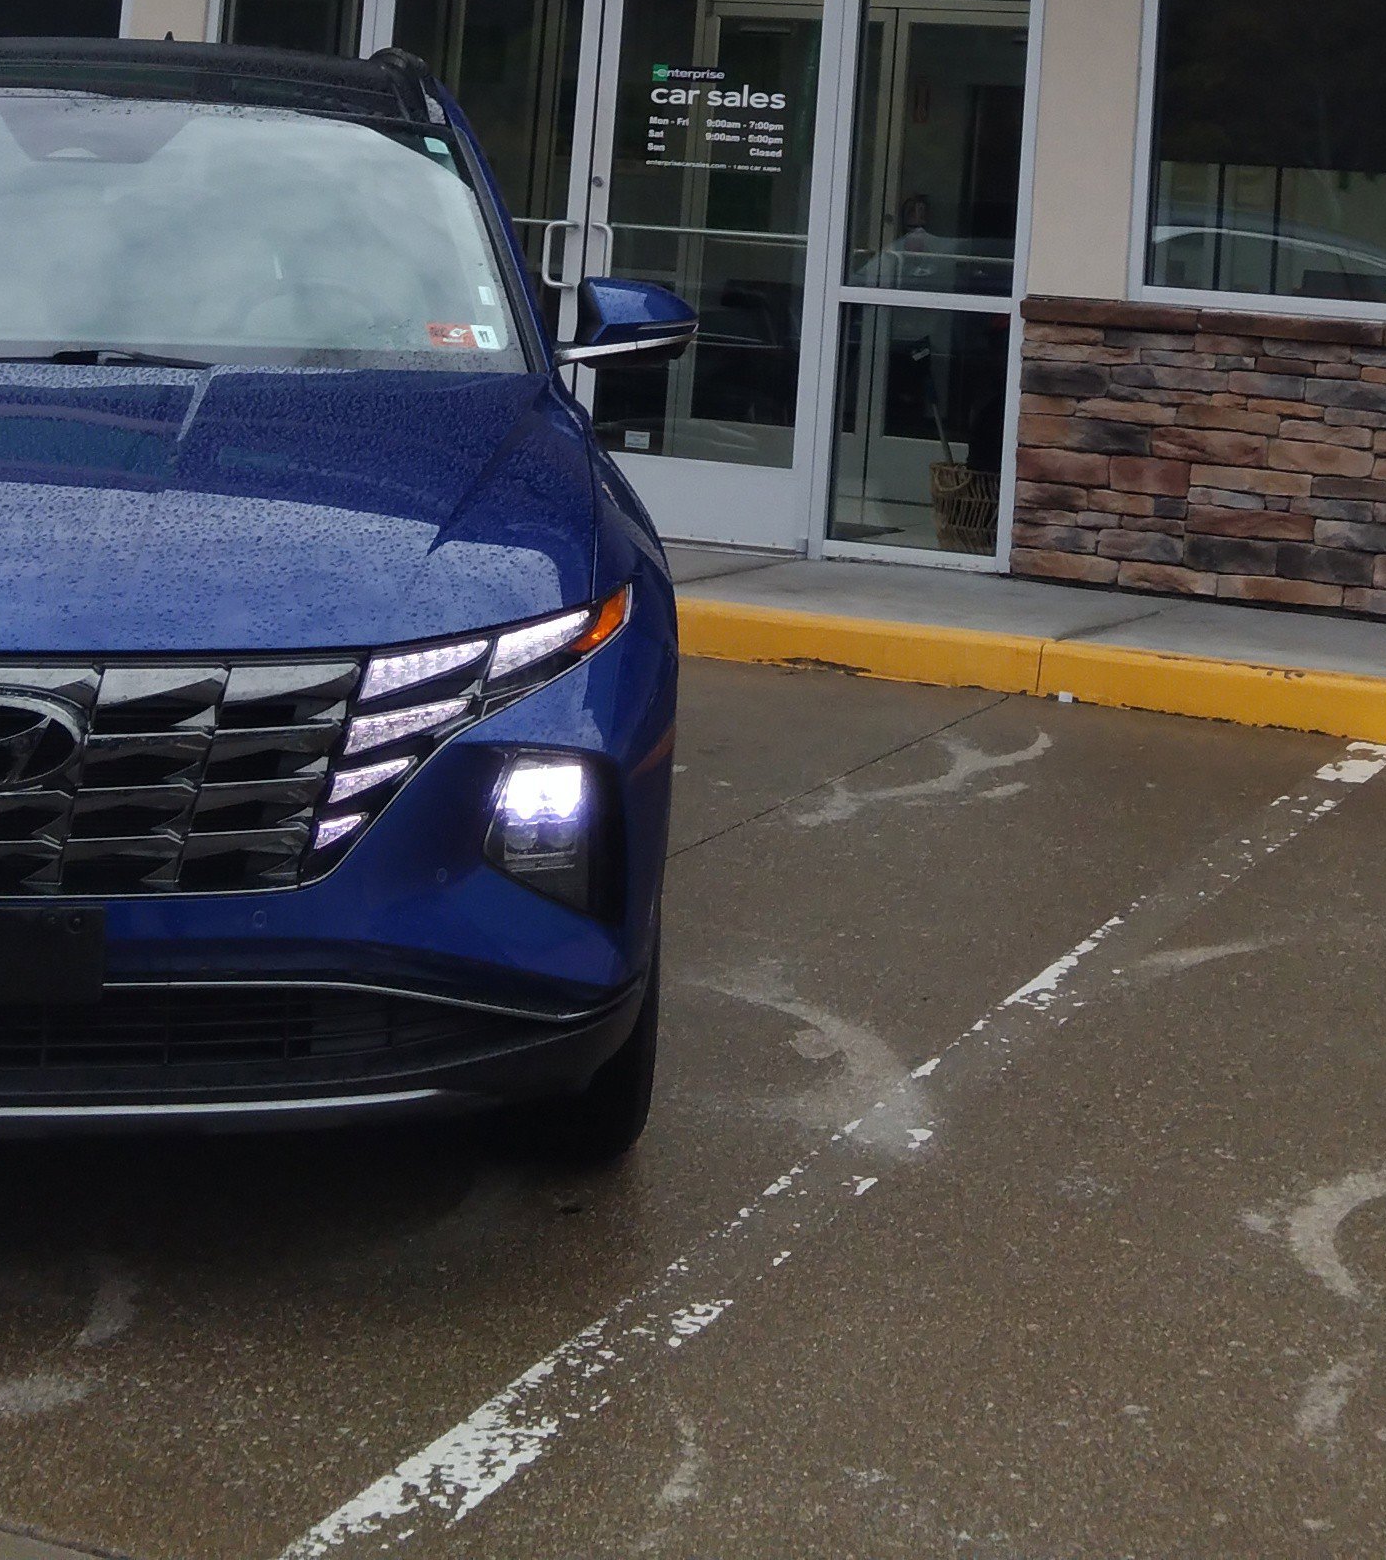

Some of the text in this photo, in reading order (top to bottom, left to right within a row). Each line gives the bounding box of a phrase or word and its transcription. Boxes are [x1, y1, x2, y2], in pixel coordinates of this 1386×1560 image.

[655, 67, 726, 81] enterprise
[650, 84, 786, 110] car sales
[649, 116, 669, 126] Mon
[676, 117, 690, 127] Fri
[706, 119, 741, 130] 9:00am
[749, 120, 784, 133] 7:00pm
[648, 129, 664, 139] Sat
[705, 131, 741, 143] 9:00am
[749, 147, 783, 158] Closed
